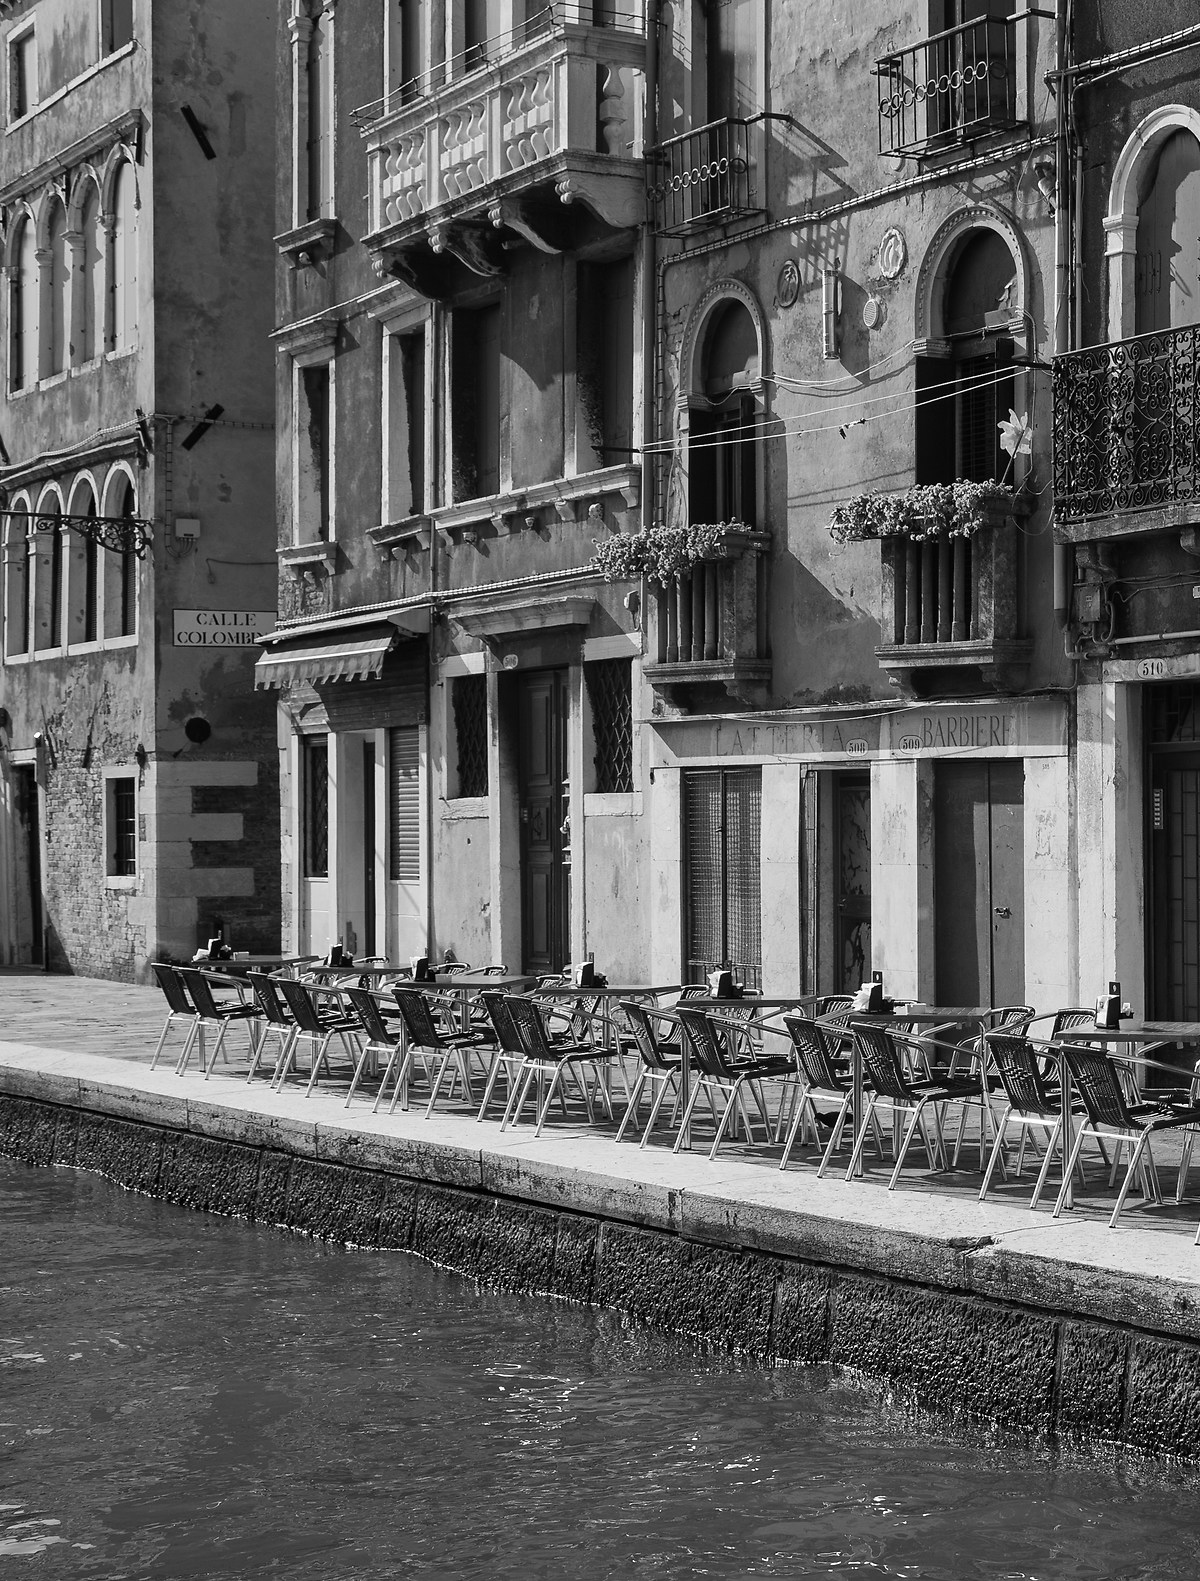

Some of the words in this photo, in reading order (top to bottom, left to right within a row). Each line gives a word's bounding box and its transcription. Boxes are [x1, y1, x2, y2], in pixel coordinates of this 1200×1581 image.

[196, 613, 257, 626] CALLE
[1142, 661, 1164, 676] 510
[922, 715, 1017, 748] BARBIERE
[848, 742, 866, 753] 508
[902, 738, 920, 750] 509
